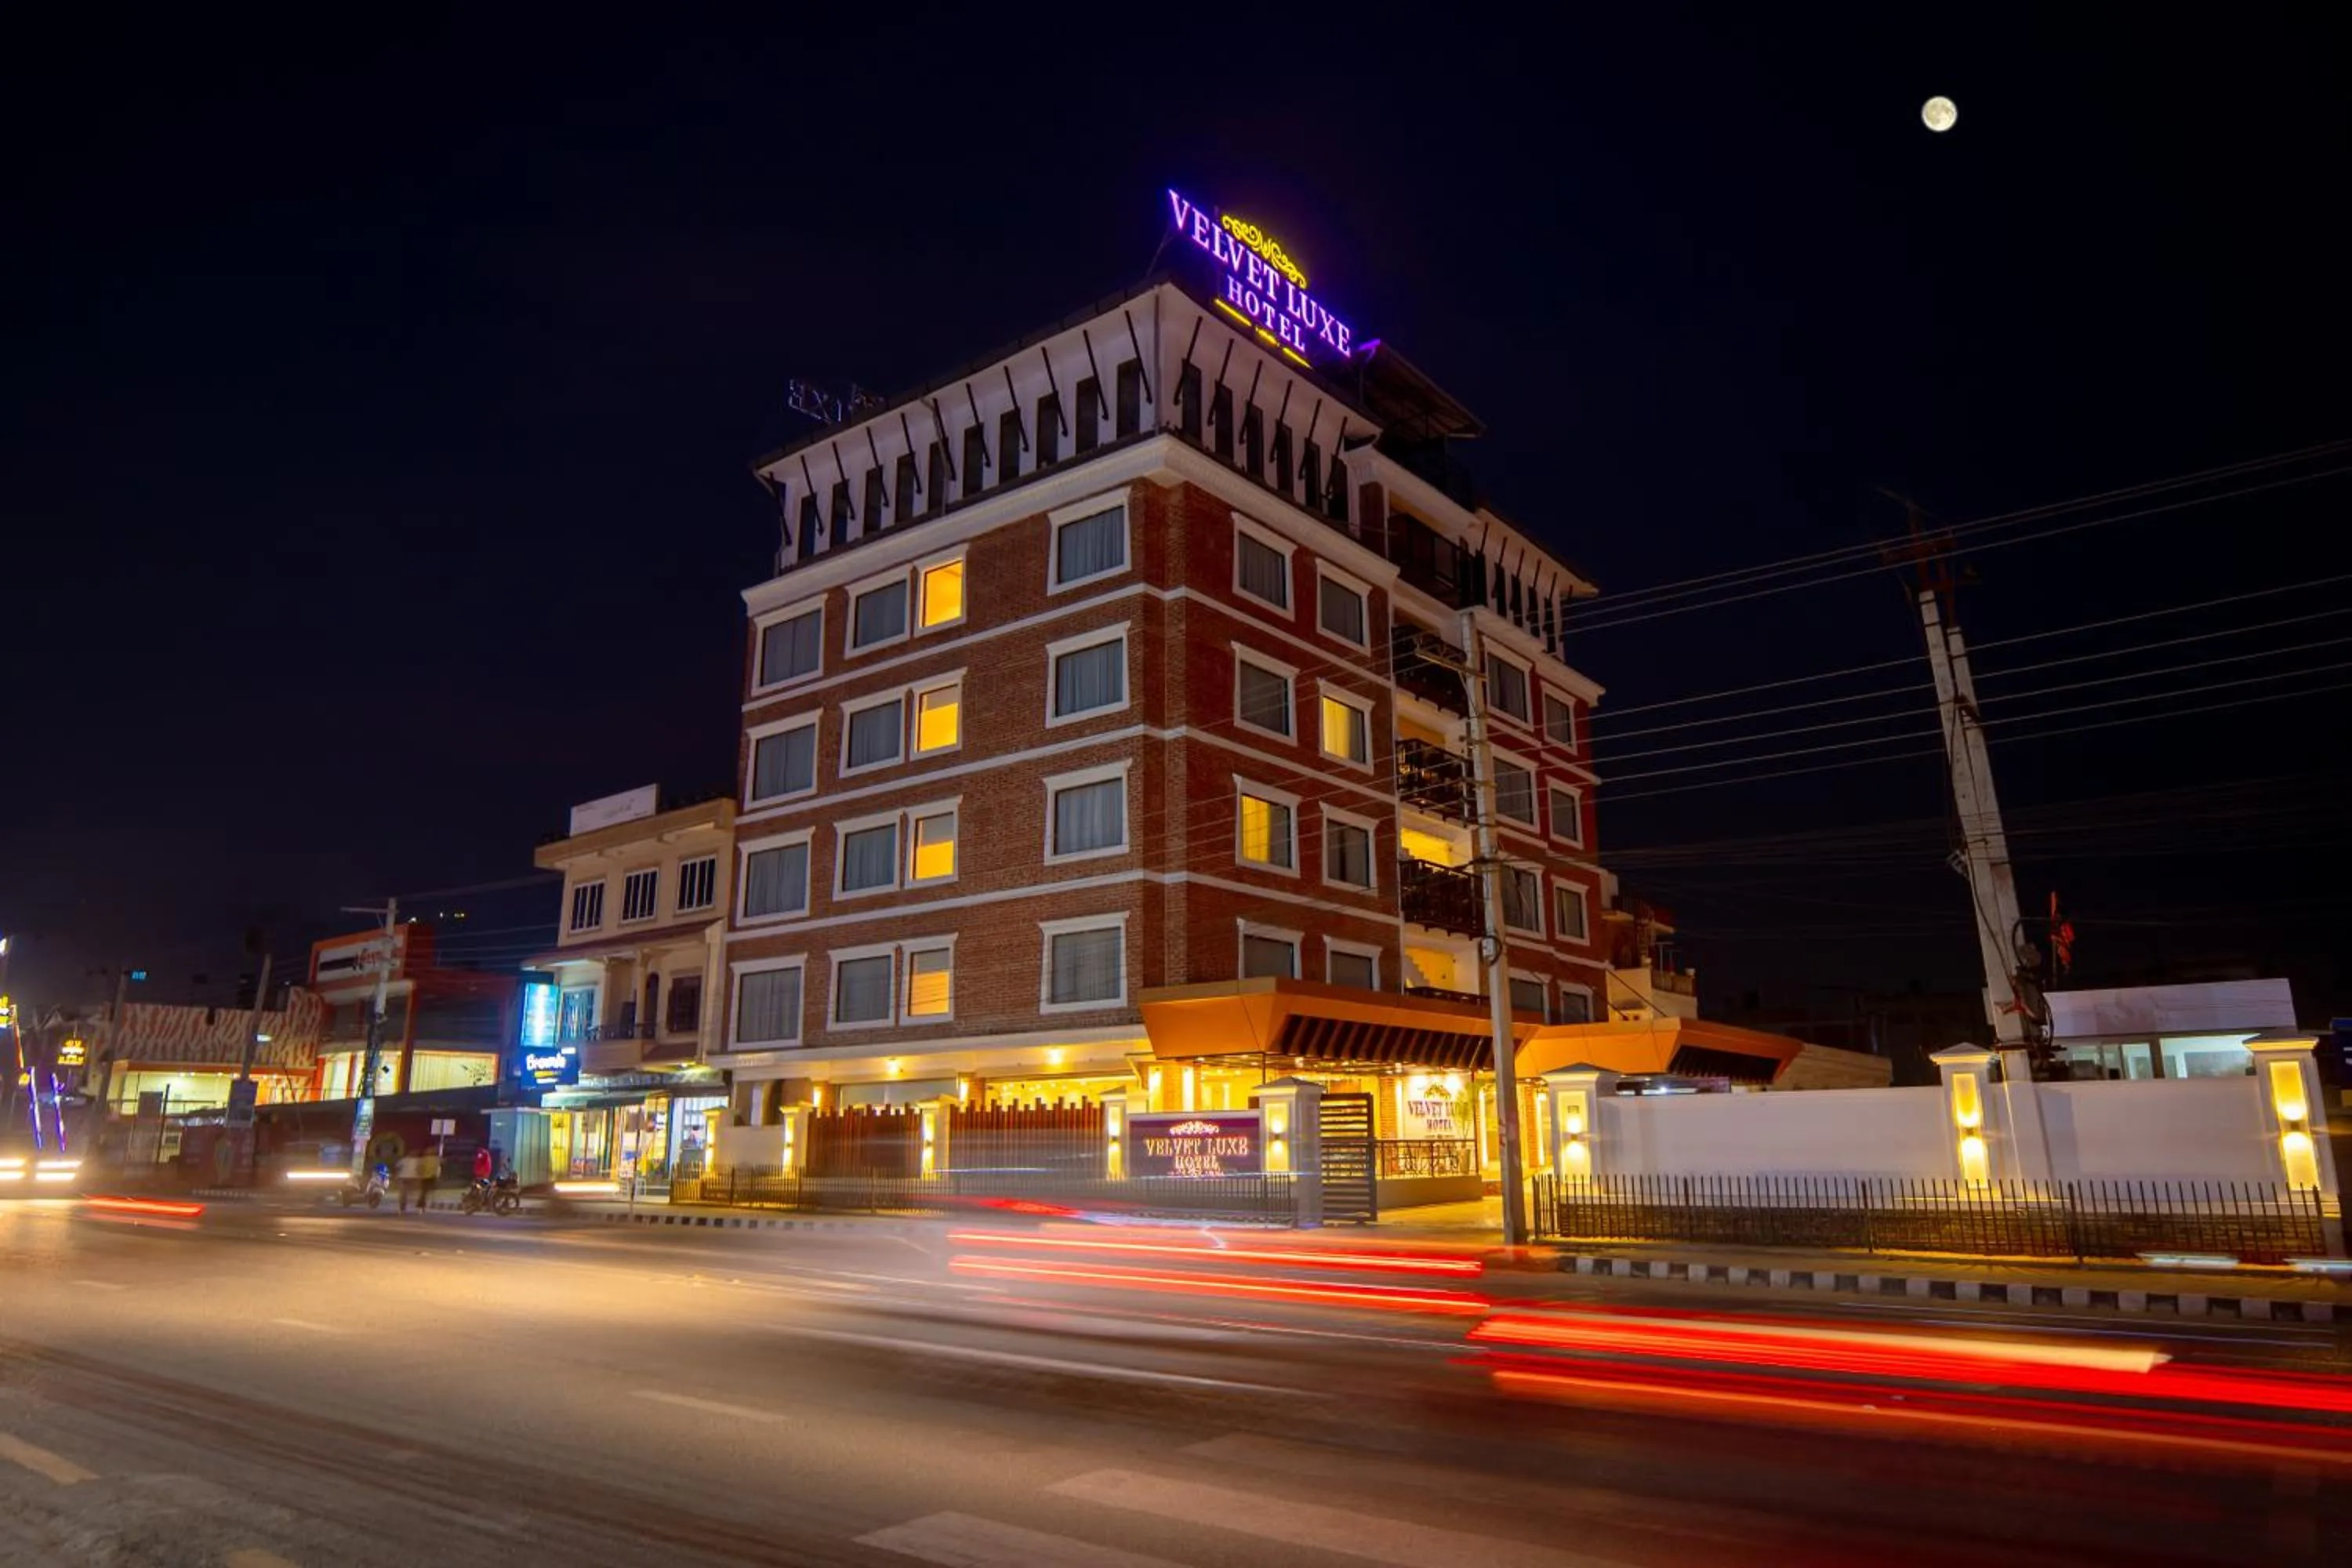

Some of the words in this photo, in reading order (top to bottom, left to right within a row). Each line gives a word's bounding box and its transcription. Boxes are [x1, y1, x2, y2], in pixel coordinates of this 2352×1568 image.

[1168, 188, 1280, 302] VELVET
[1286, 281, 1351, 358] LUXE
[1227, 275, 1305, 353] HOTEL
[1145, 1138, 1201, 1156] VELVET
[1207, 1137, 1249, 1156] LUXE
[1174, 1154, 1220, 1171] HOTEL
